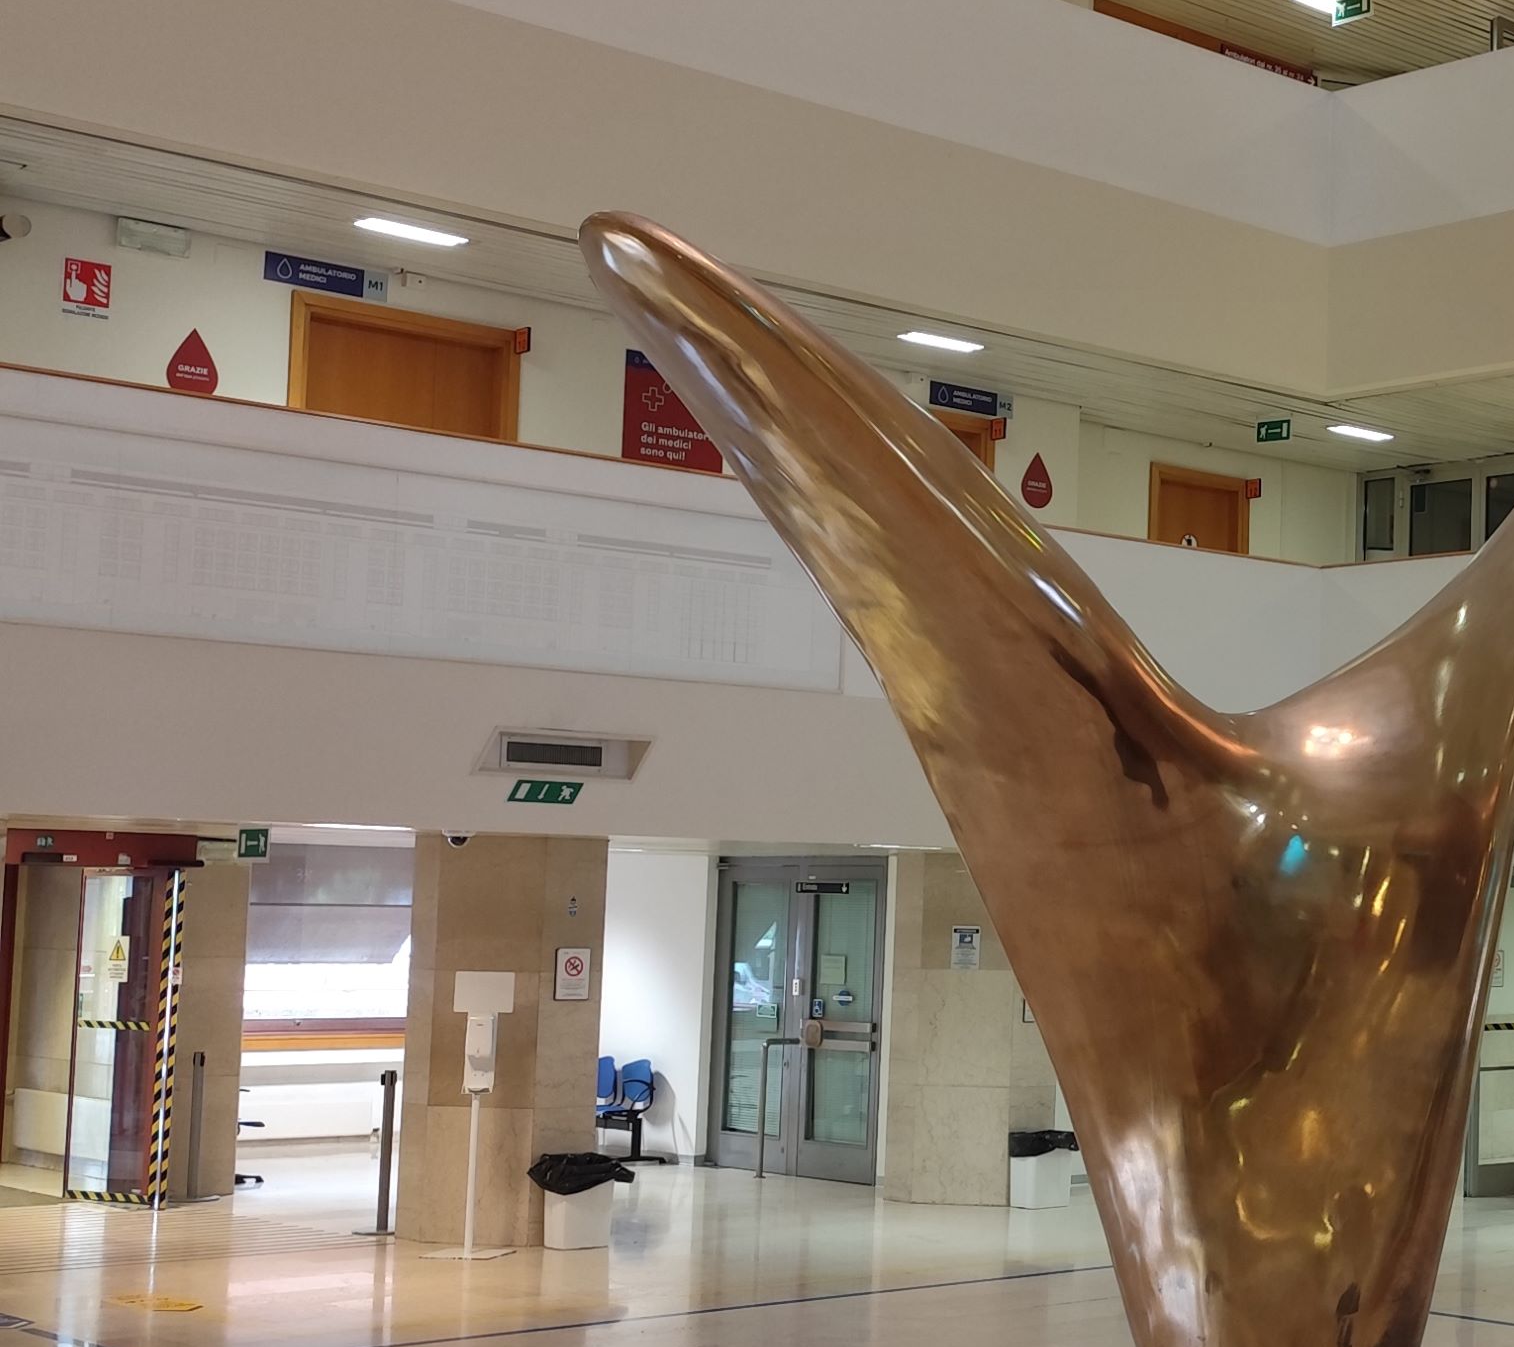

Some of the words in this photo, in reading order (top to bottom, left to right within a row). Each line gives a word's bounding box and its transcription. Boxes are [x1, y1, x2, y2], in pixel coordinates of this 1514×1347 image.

[298, 272, 327, 284] MEDICI
[299, 263, 357, 281] AMBULATORIO
[368, 280, 383, 292] M1
[177, 364, 209, 376] GRAZIE
[1000, 401, 1012, 412] M2
[641, 421, 656, 433] Gli
[657, 425, 710, 441] ambulator
[640, 433, 657, 445] dei
[659, 437, 692, 451] medici
[640, 446, 665, 458] sono
[666, 450, 686, 462] qui!
